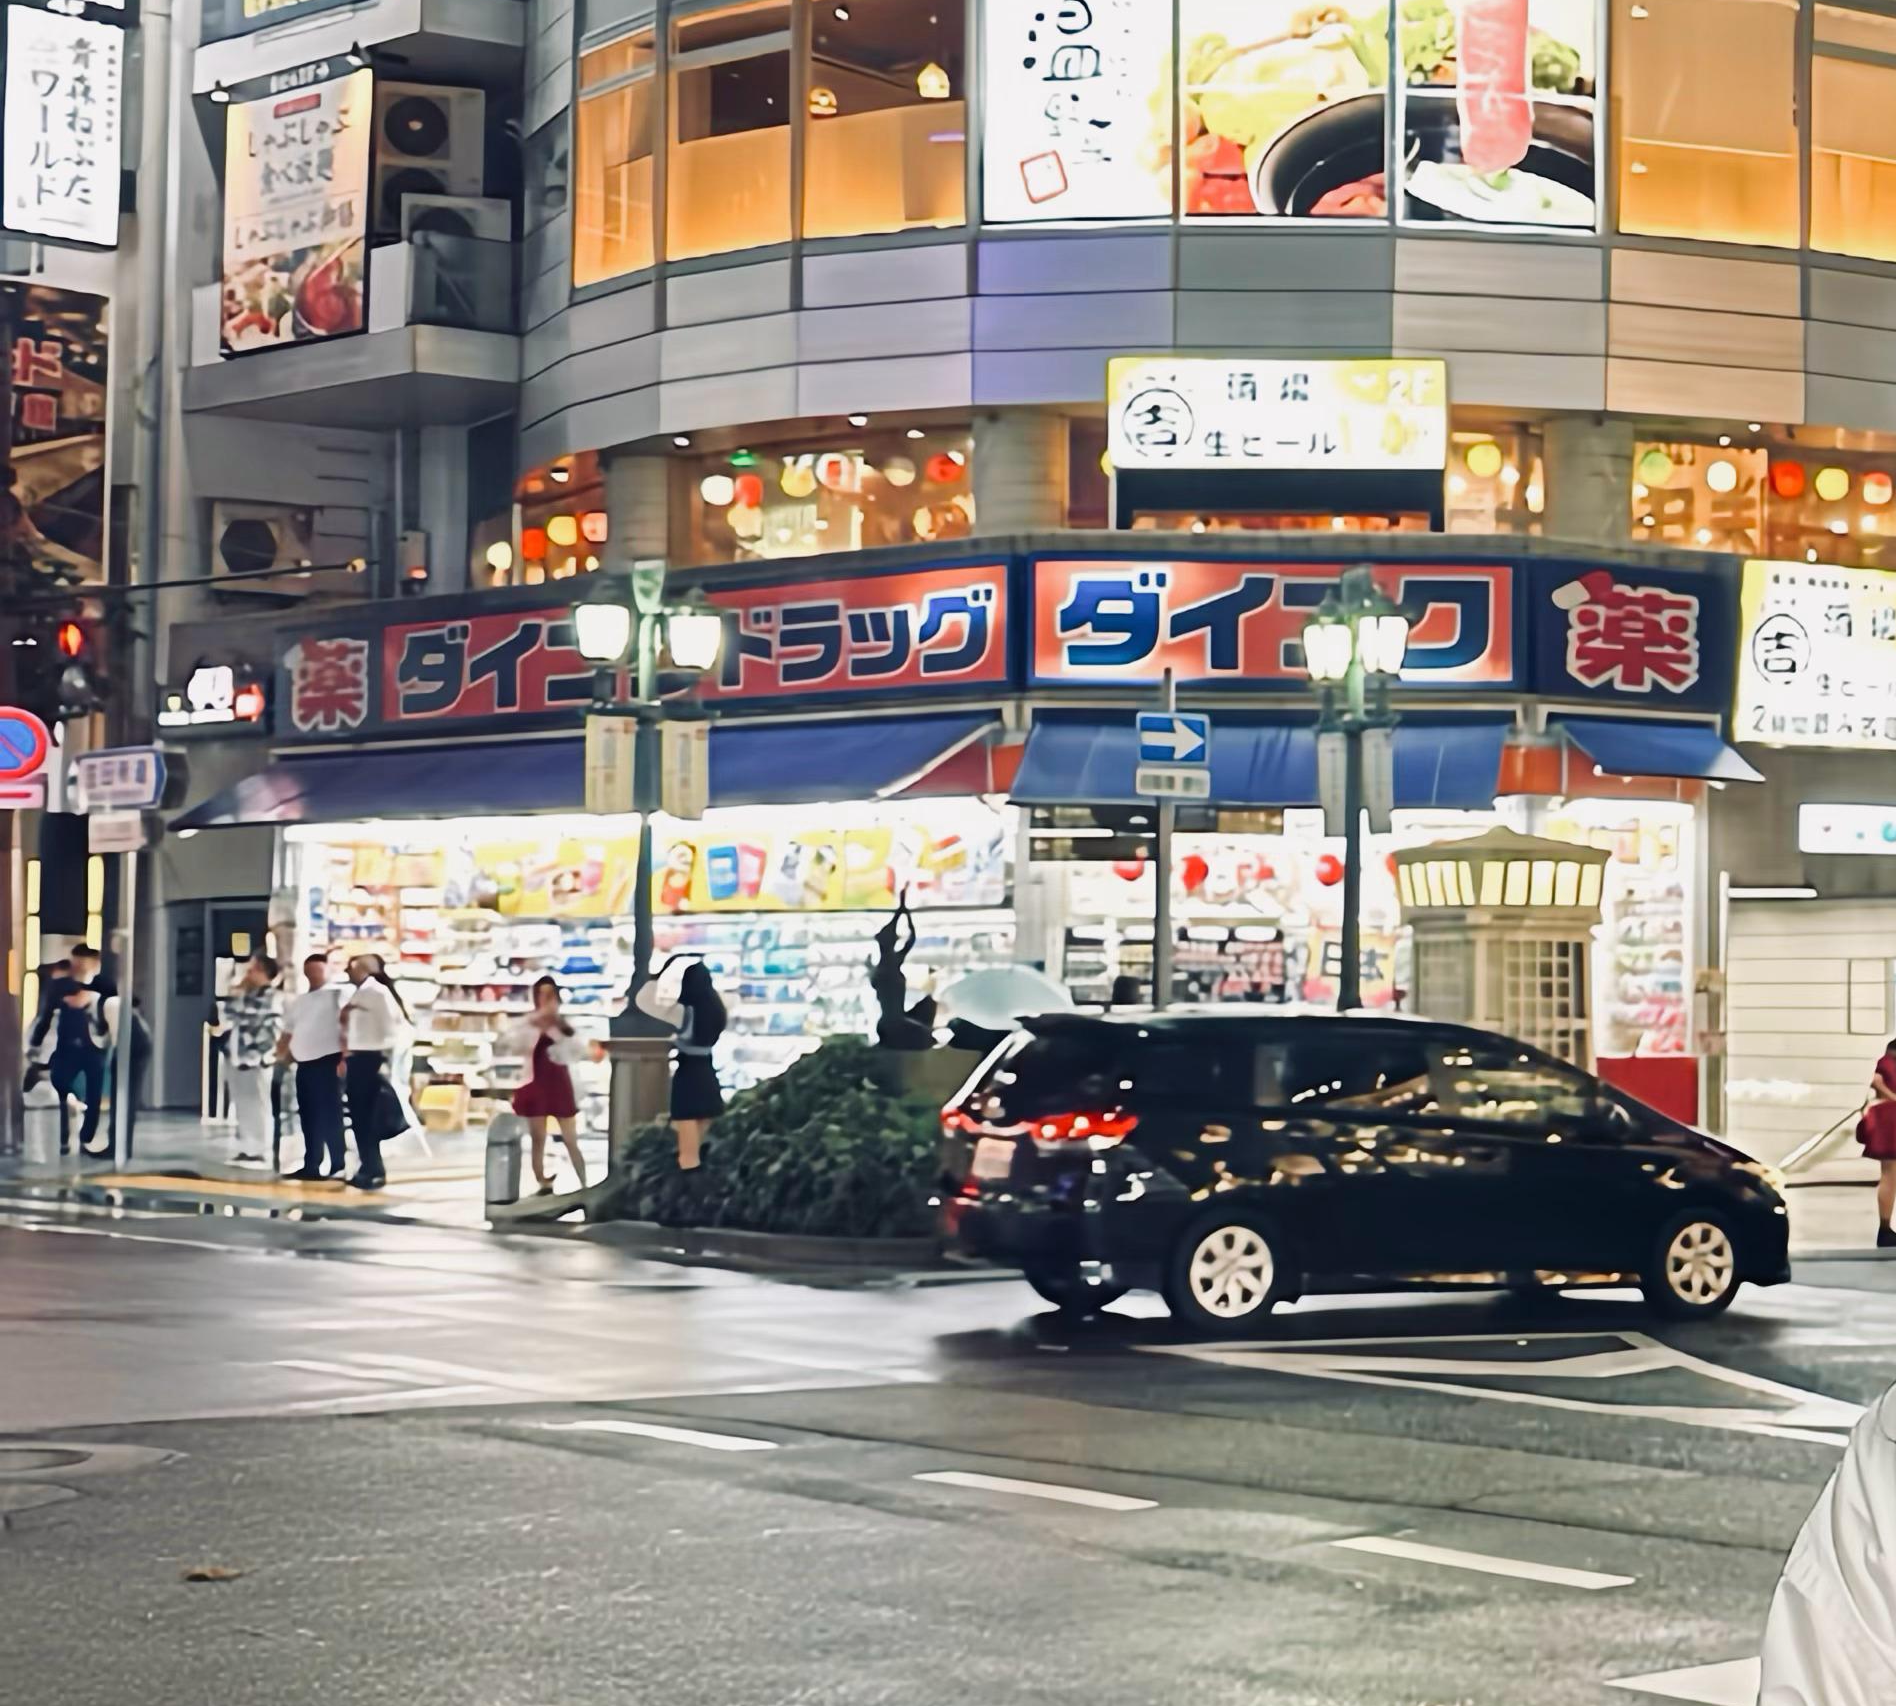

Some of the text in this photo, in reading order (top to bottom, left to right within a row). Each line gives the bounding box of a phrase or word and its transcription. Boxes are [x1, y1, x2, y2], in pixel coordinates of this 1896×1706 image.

[291, 637, 370, 733] 薬
[397, 584, 996, 719] ダイコドラッグ
[1564, 571, 1700, 693] 薬
